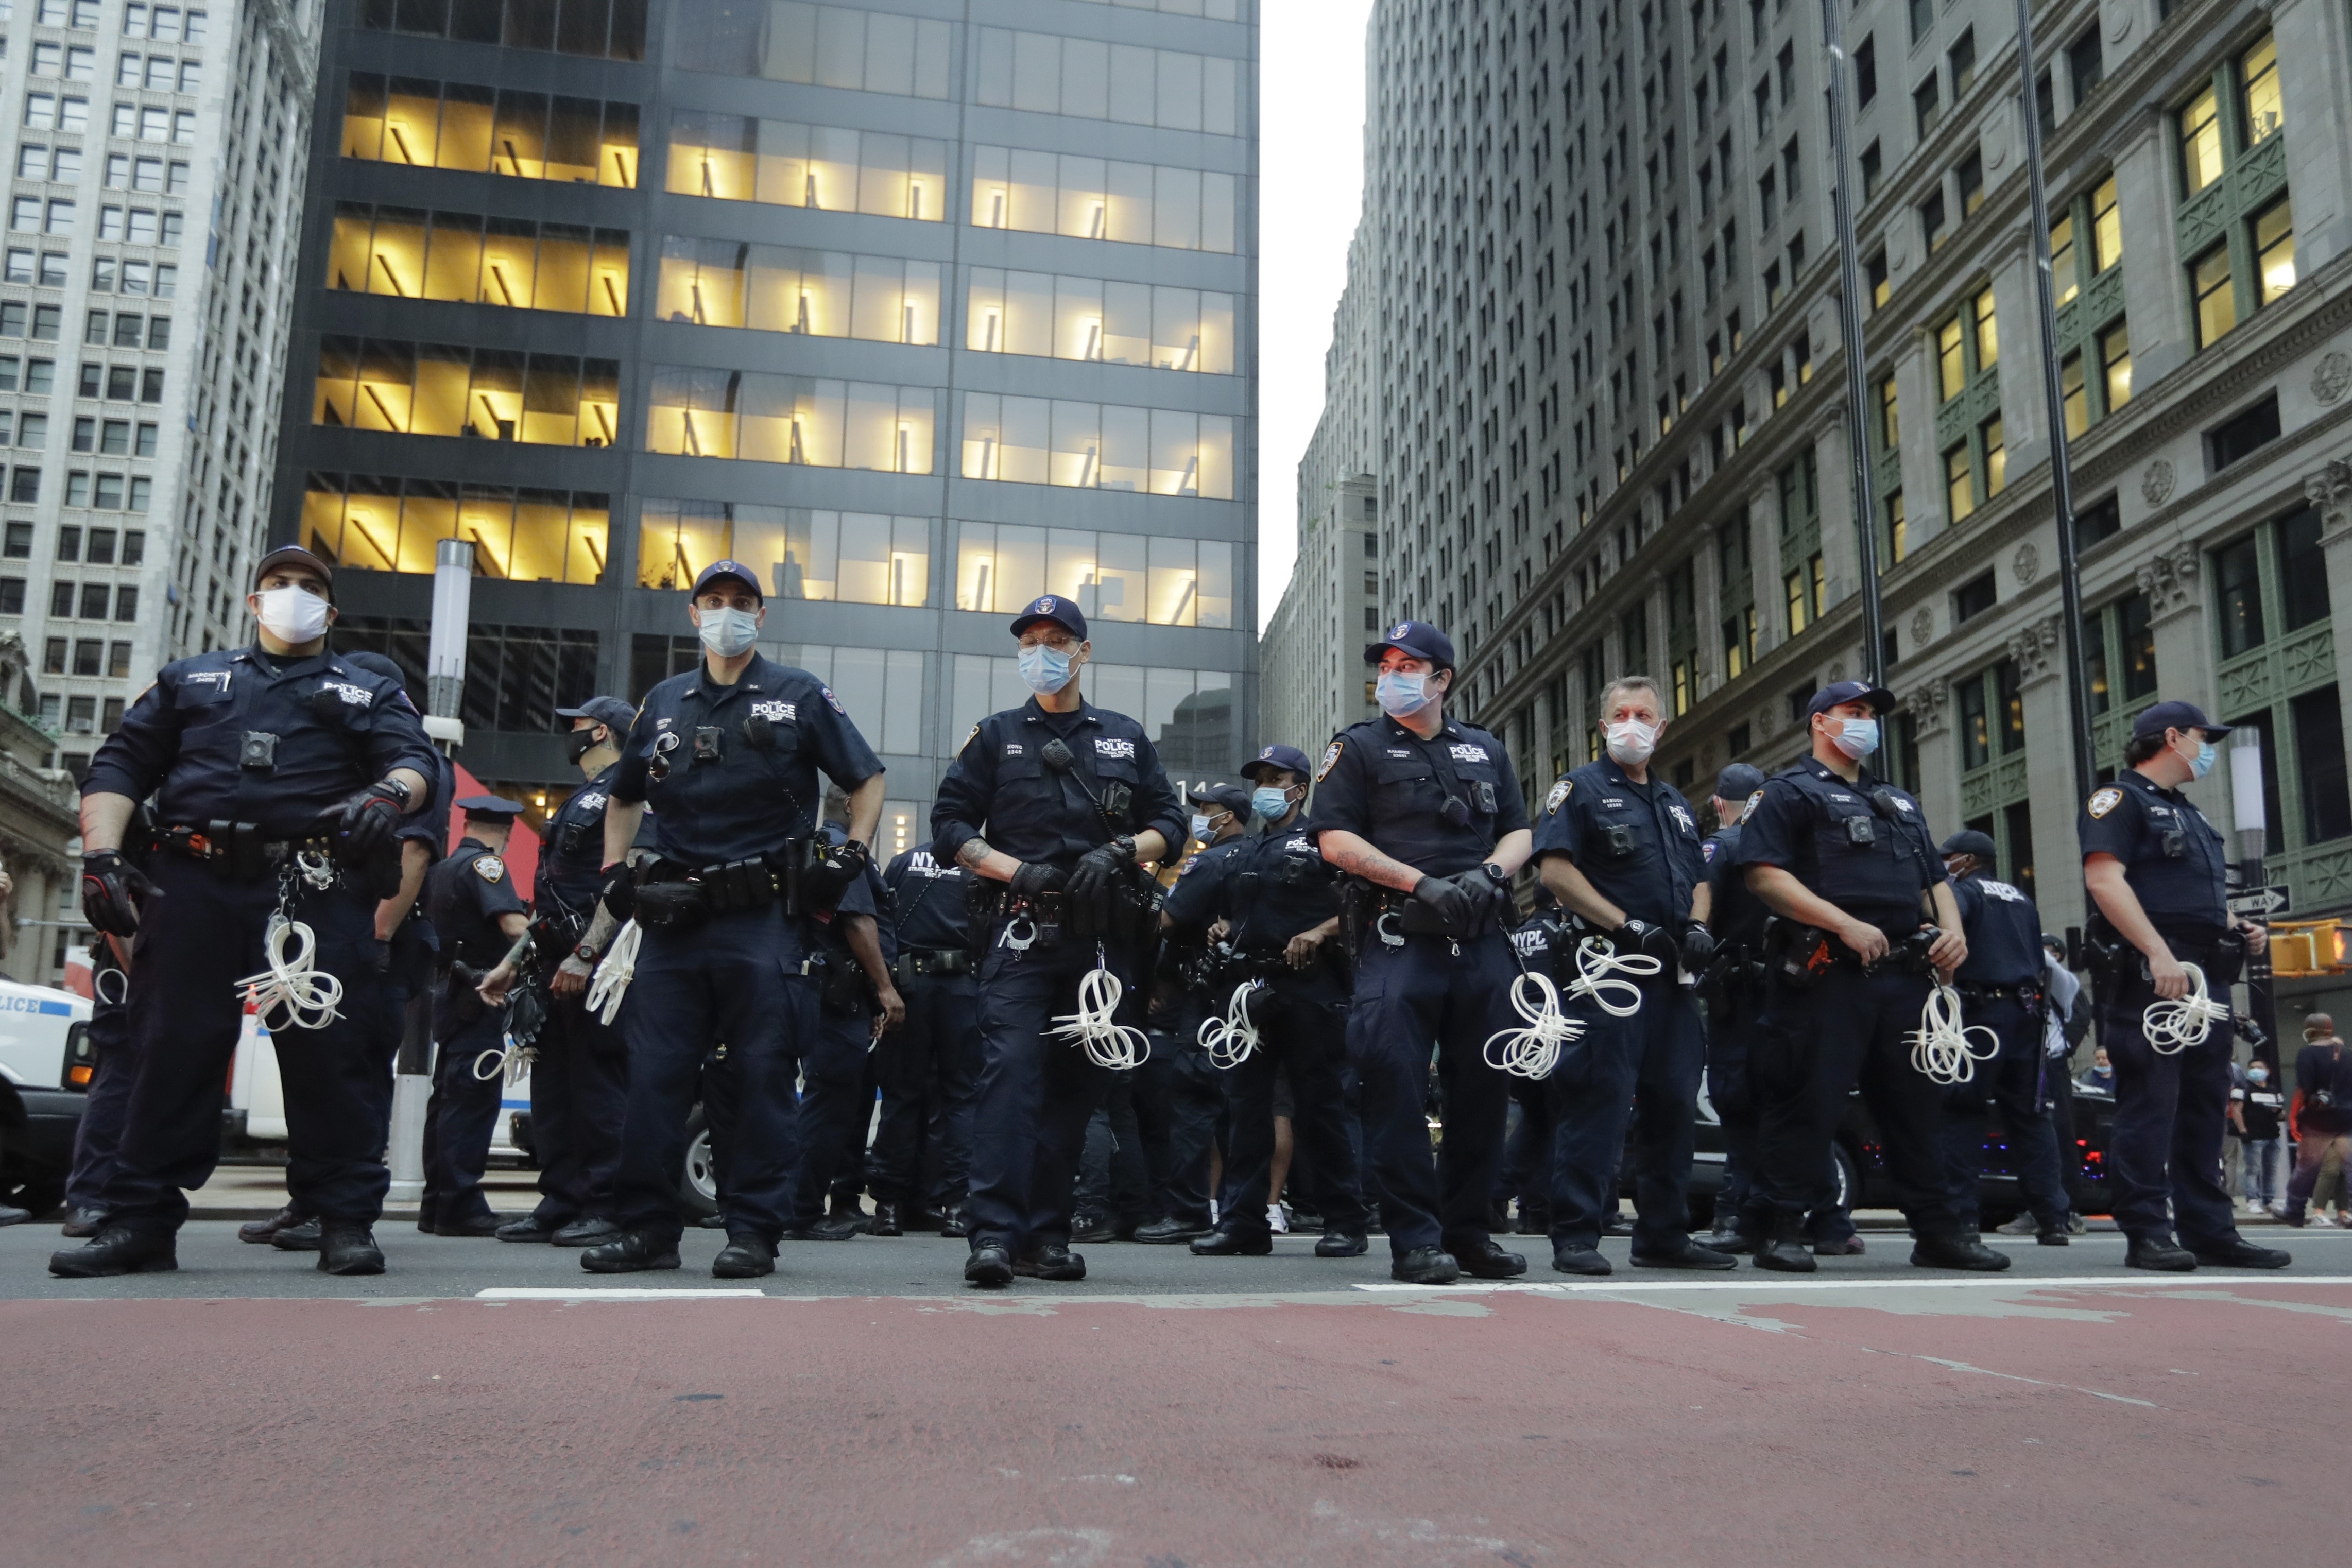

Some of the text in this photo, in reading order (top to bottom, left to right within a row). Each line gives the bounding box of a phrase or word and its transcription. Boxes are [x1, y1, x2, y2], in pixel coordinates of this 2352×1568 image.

[752, 703, 796, 715] POLICE
[1095, 739, 1135, 754] POLICE
[1449, 747, 1486, 756] POLICE
[2251, 894, 2276, 908] WAY
